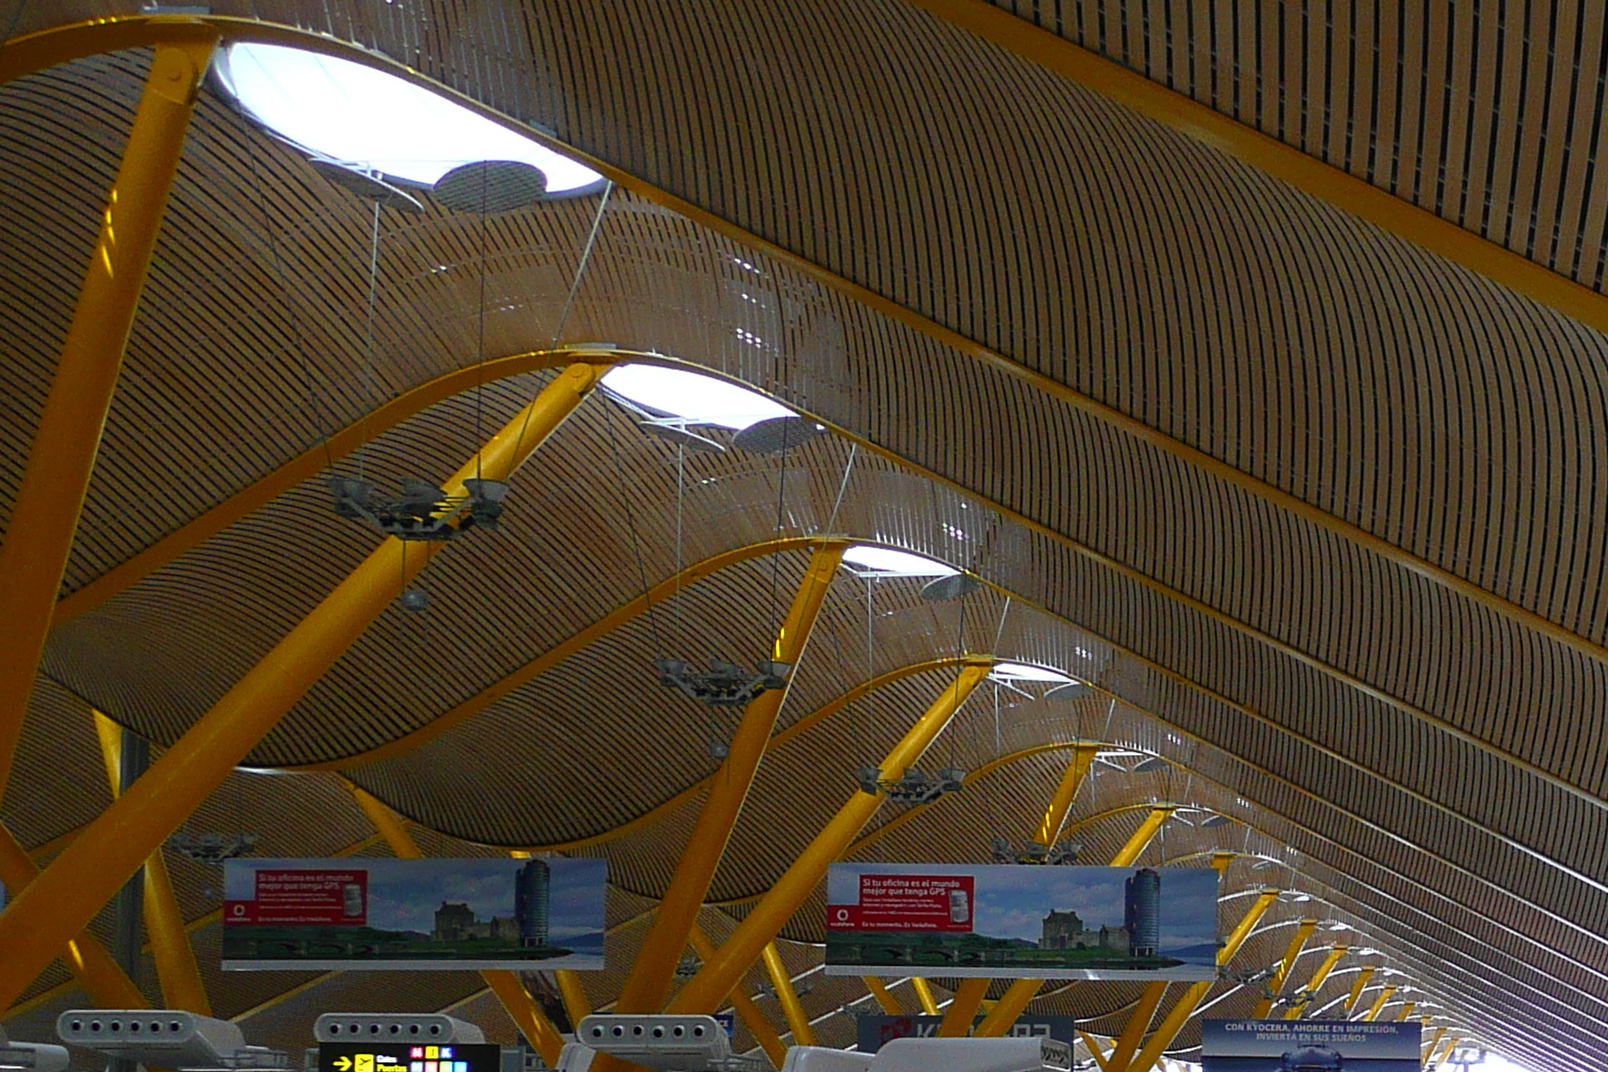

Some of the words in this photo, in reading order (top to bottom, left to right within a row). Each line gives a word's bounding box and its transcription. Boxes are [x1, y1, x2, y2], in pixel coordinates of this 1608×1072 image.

[863, 879, 870, 887] Si
[872, 879, 881, 887] tu
[882, 879, 909, 887] oficina
[921, 879, 930, 887] el
[931, 879, 960, 887] mundo
[863, 887, 886, 895] mejor
[888, 888, 903, 896] que
[905, 888, 928, 897] tenga
[929, 888, 945, 896] GPS
[1293, 1024, 1329, 1032] AHORRE
[1332, 1025, 1344, 1033] EN
[1256, 1033, 1298, 1041] INVIERTA
